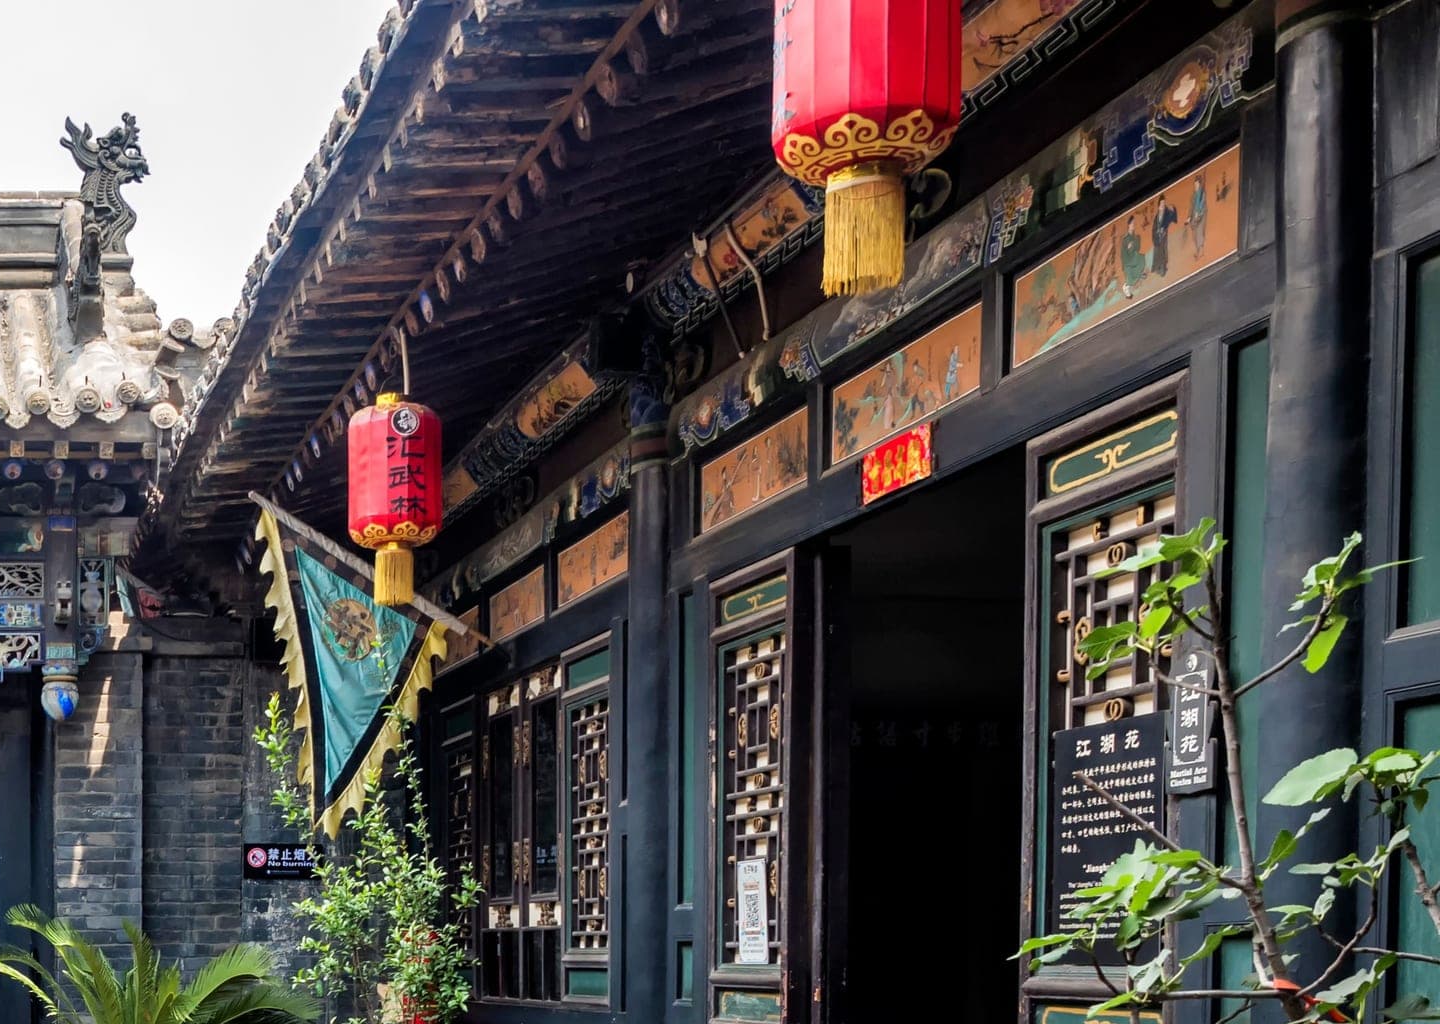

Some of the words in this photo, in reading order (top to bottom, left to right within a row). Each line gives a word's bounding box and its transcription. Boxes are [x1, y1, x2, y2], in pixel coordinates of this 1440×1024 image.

[386, 435, 428, 518] 汇武林
[1075, 729, 1140, 758] 江湖苑
[282, 860, 318, 869] burning
